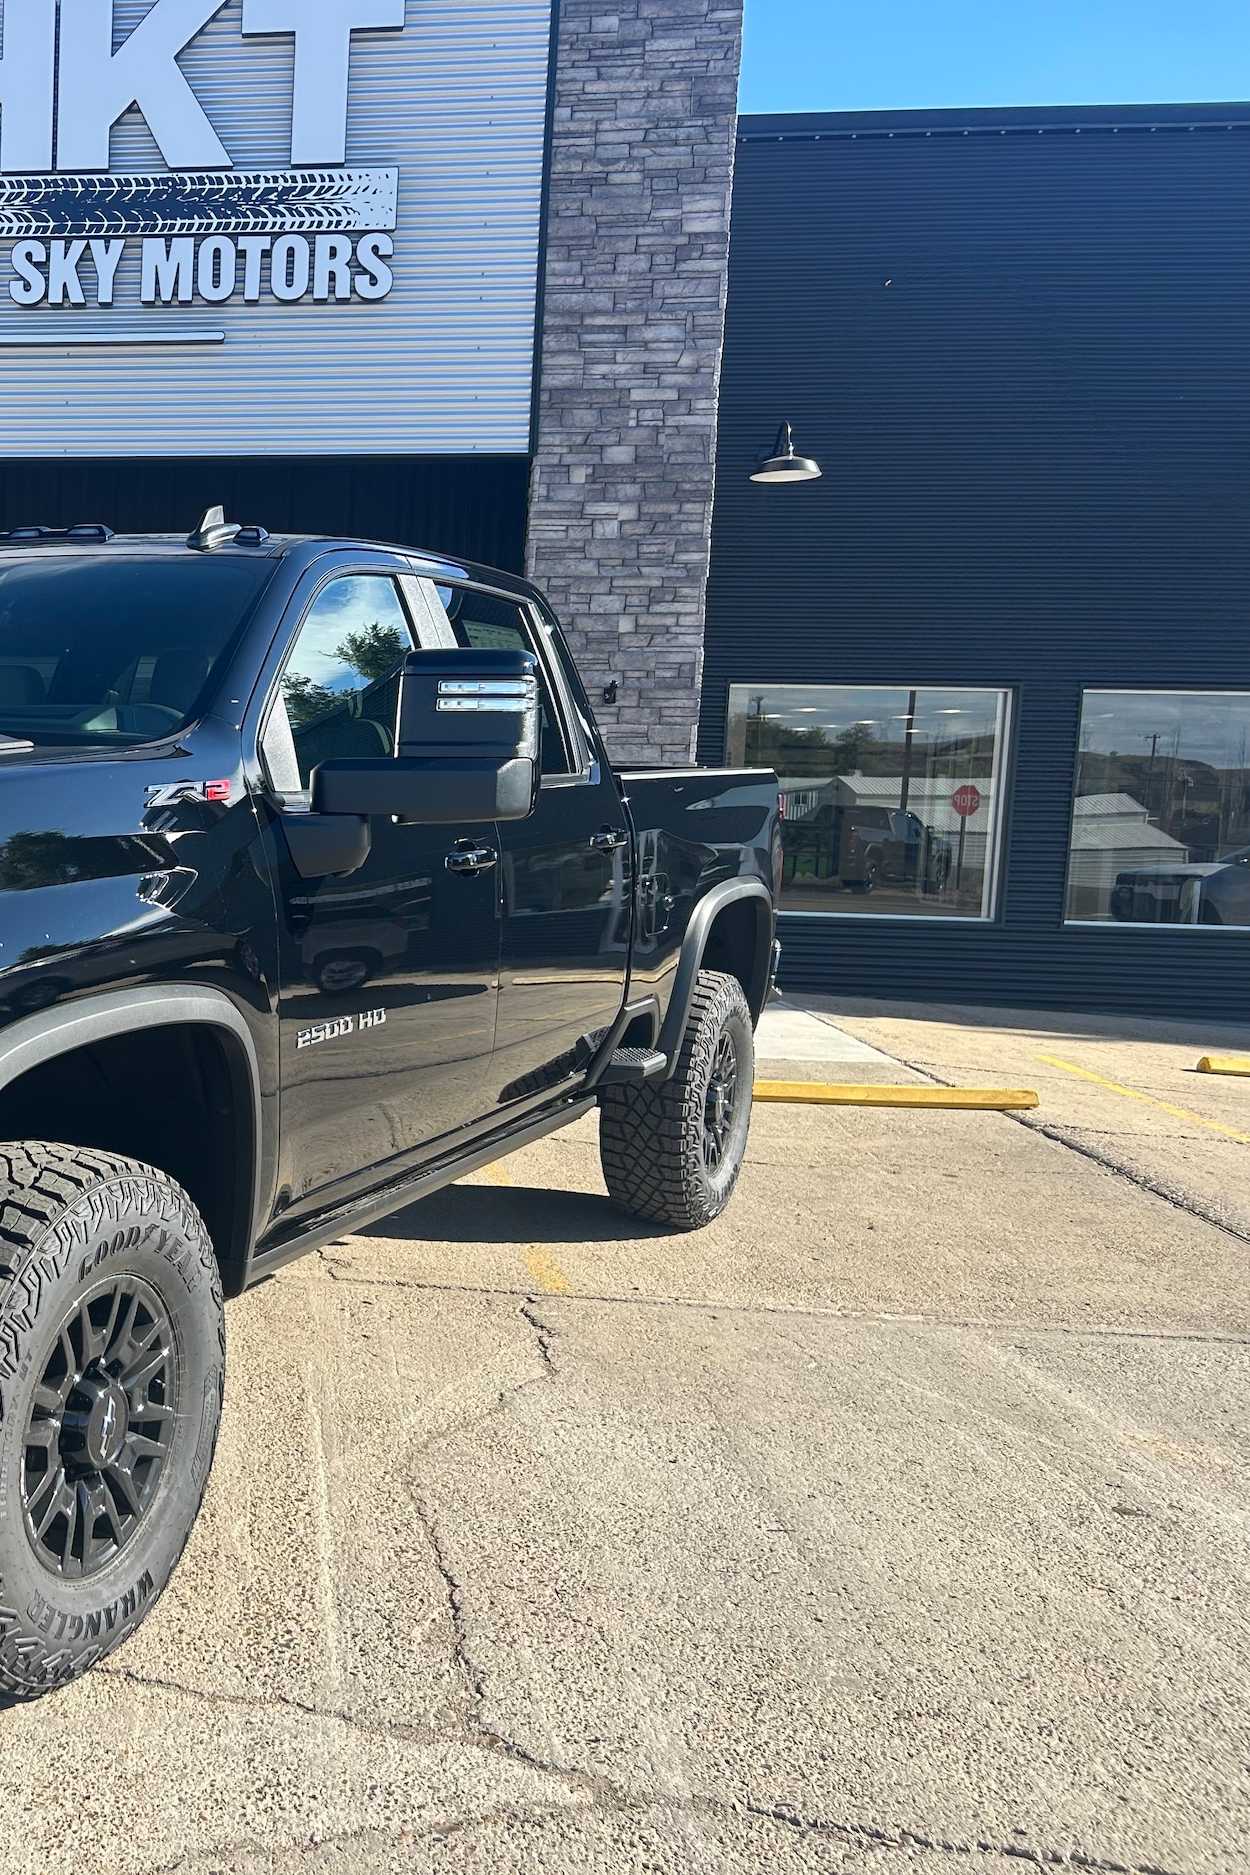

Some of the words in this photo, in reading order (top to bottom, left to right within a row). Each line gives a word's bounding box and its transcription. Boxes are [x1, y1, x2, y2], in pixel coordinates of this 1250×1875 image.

[8, 239, 126, 307] SKY
[140, 232, 395, 305] MOTORS
[144, 779, 230, 808] ZR2
[296, 1016, 354, 1049] 2500
[358, 1007, 387, 1030] HD
[26, 1568, 155, 1643] WRANGLER
